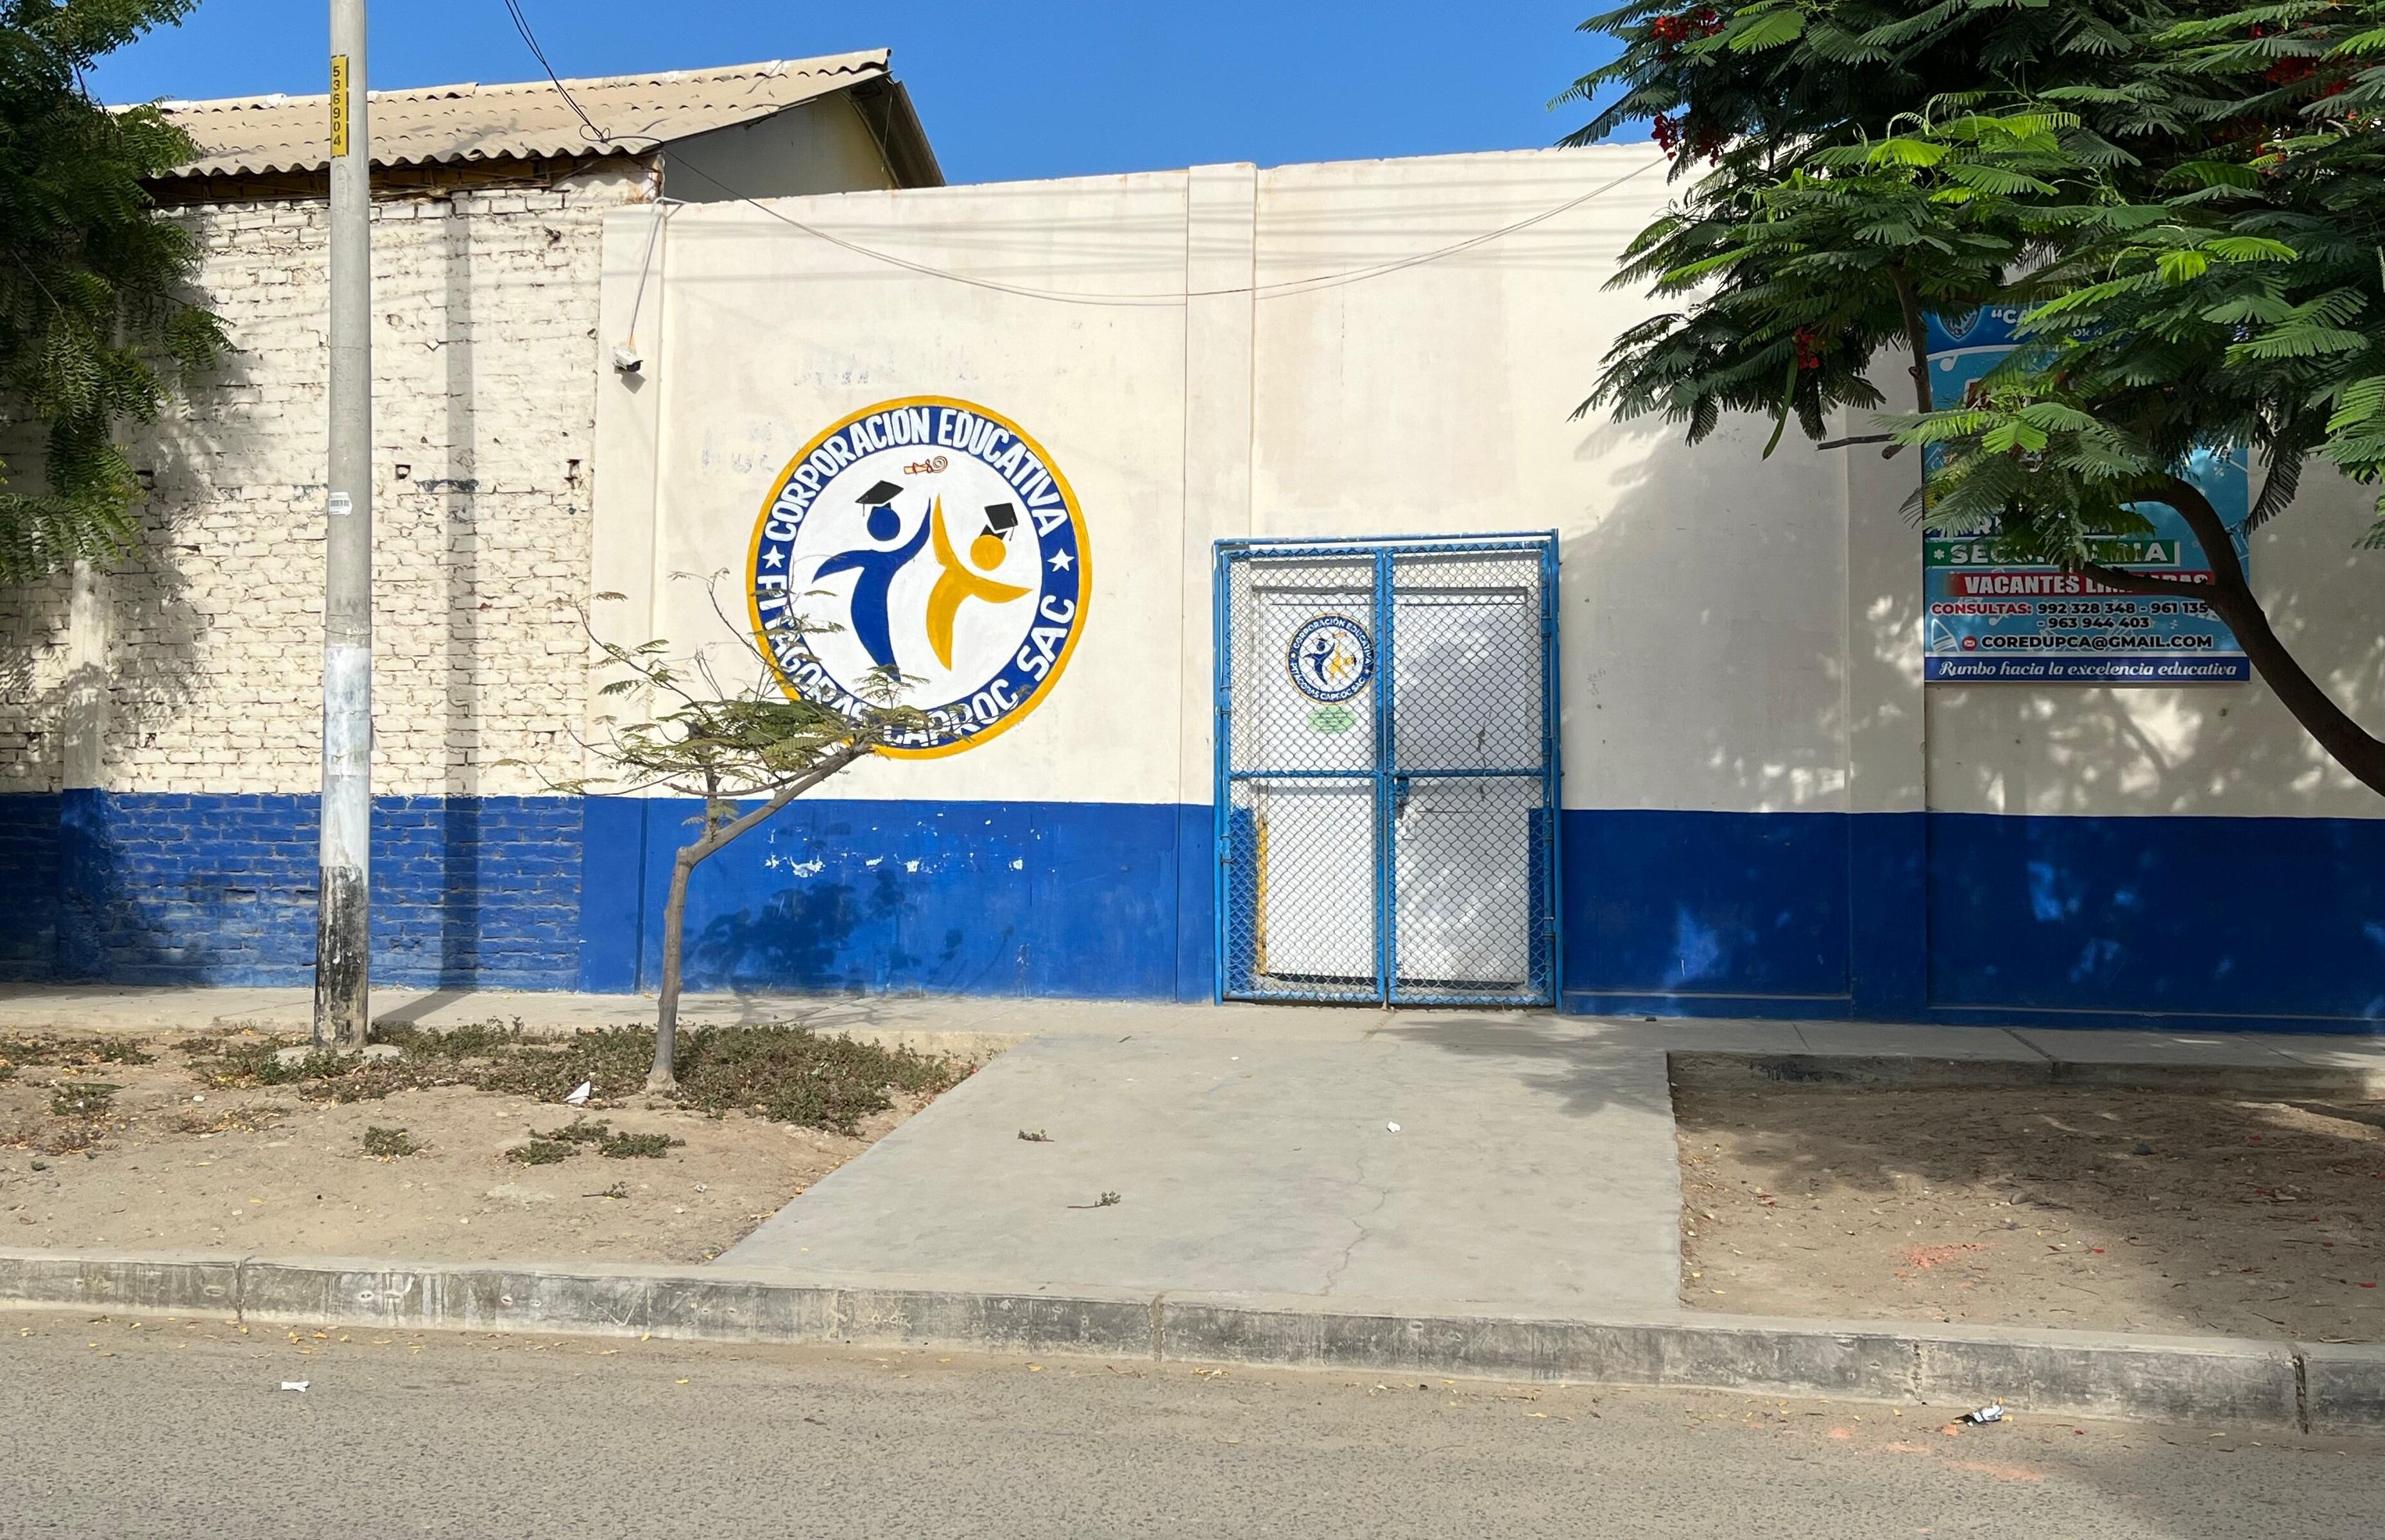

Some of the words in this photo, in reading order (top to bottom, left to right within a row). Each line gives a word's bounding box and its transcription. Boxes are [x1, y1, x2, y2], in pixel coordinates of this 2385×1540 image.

[332, 65, 341, 146] 536904
[764, 406, 930, 542] CORPORACIÓN
[937, 407, 1069, 537] EDUCATIVA
[1965, 576, 2080, 594] VACANTES
[1931, 603, 2033, 615] CONSULTAS:
[2037, 603, 2067, 615] 992
[2071, 603, 2100, 614] 328
[2105, 603, 2135, 614] 348
[2150, 603, 2178, 614] 961
[2182, 602, 2208, 614] 135
[2047, 617, 2078, 628] 963
[2082, 617, 2115, 628] 944
[2119, 617, 2150, 628] 403
[1016, 594, 1075, 683] SAC
[1345, 621, 1372, 665] EDUCATIVA
[1981, 636, 2212, 650] COREDUPCA@GMAIL.COM
[1938, 661, 1996, 676] Rumbo
[2000, 661, 2045, 675] hacia
[2048, 662, 2064, 675] la
[2067, 662, 2155, 676] excelencia
[2158, 661, 2237, 676] educativa
[1351, 677, 1365, 693] SAC
